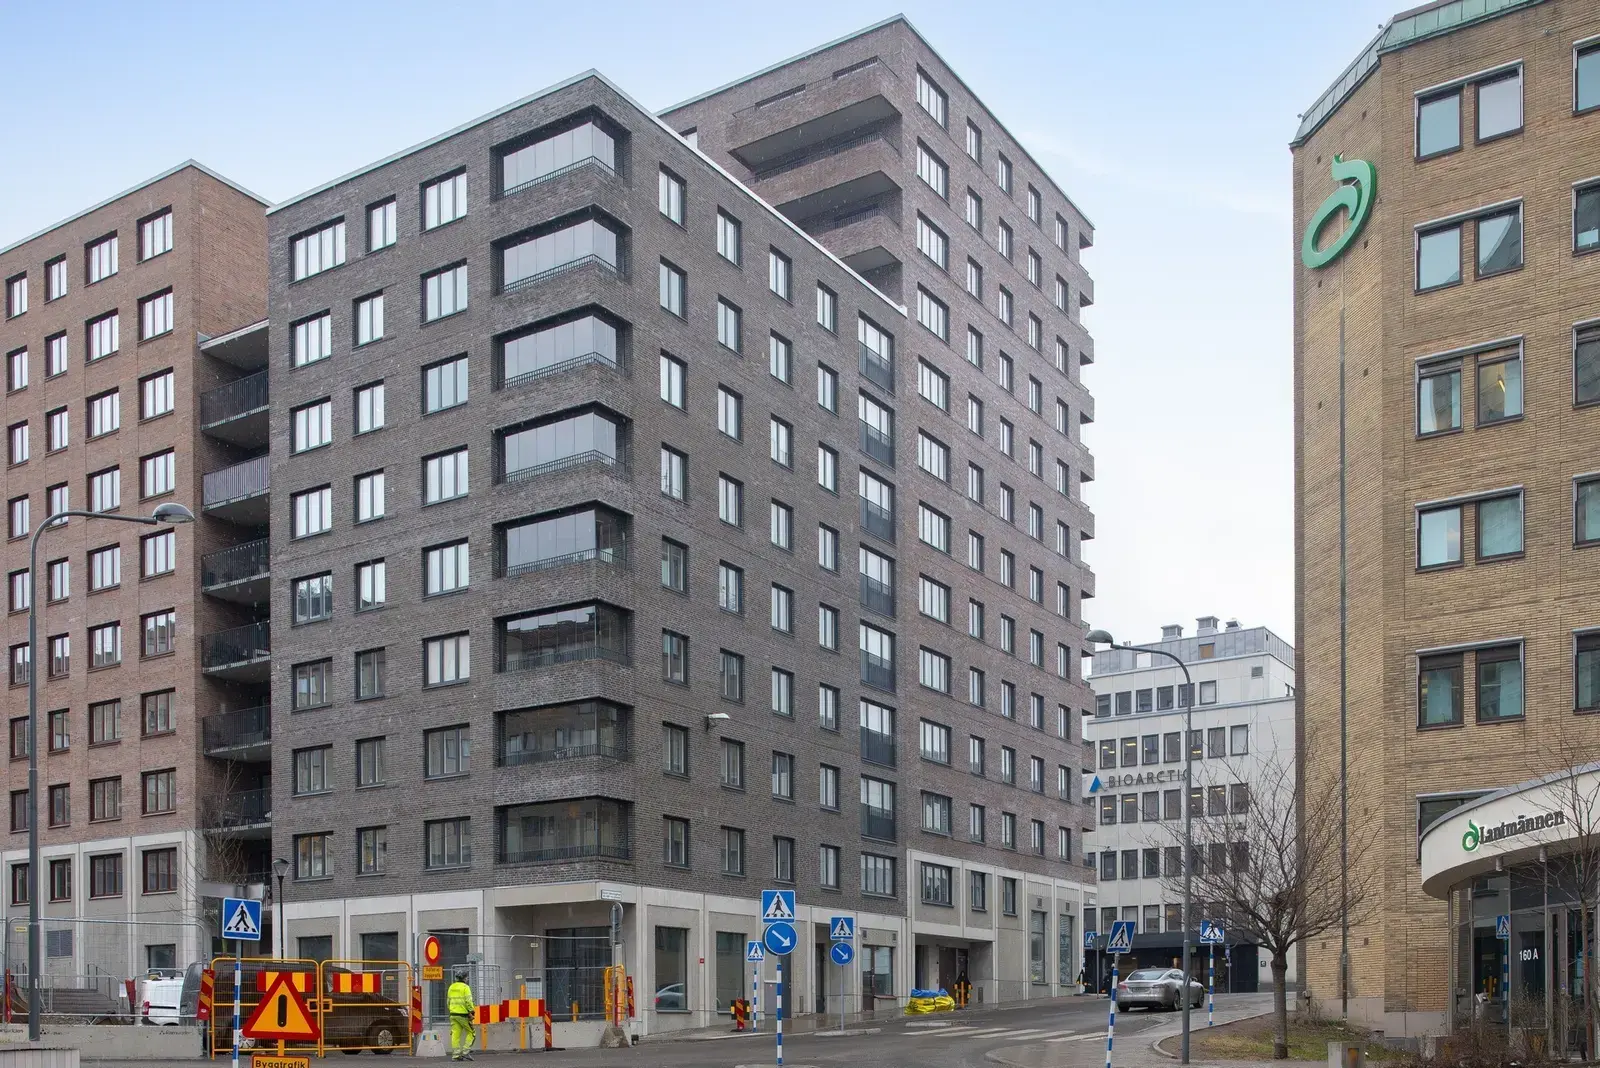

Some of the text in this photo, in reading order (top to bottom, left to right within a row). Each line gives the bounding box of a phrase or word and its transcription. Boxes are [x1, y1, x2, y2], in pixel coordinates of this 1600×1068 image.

[1479, 810, 1565, 844] Lantmännen
[1519, 947, 1539, 961] 160 A
[255, 1060, 305, 1068] Byggtrafik
